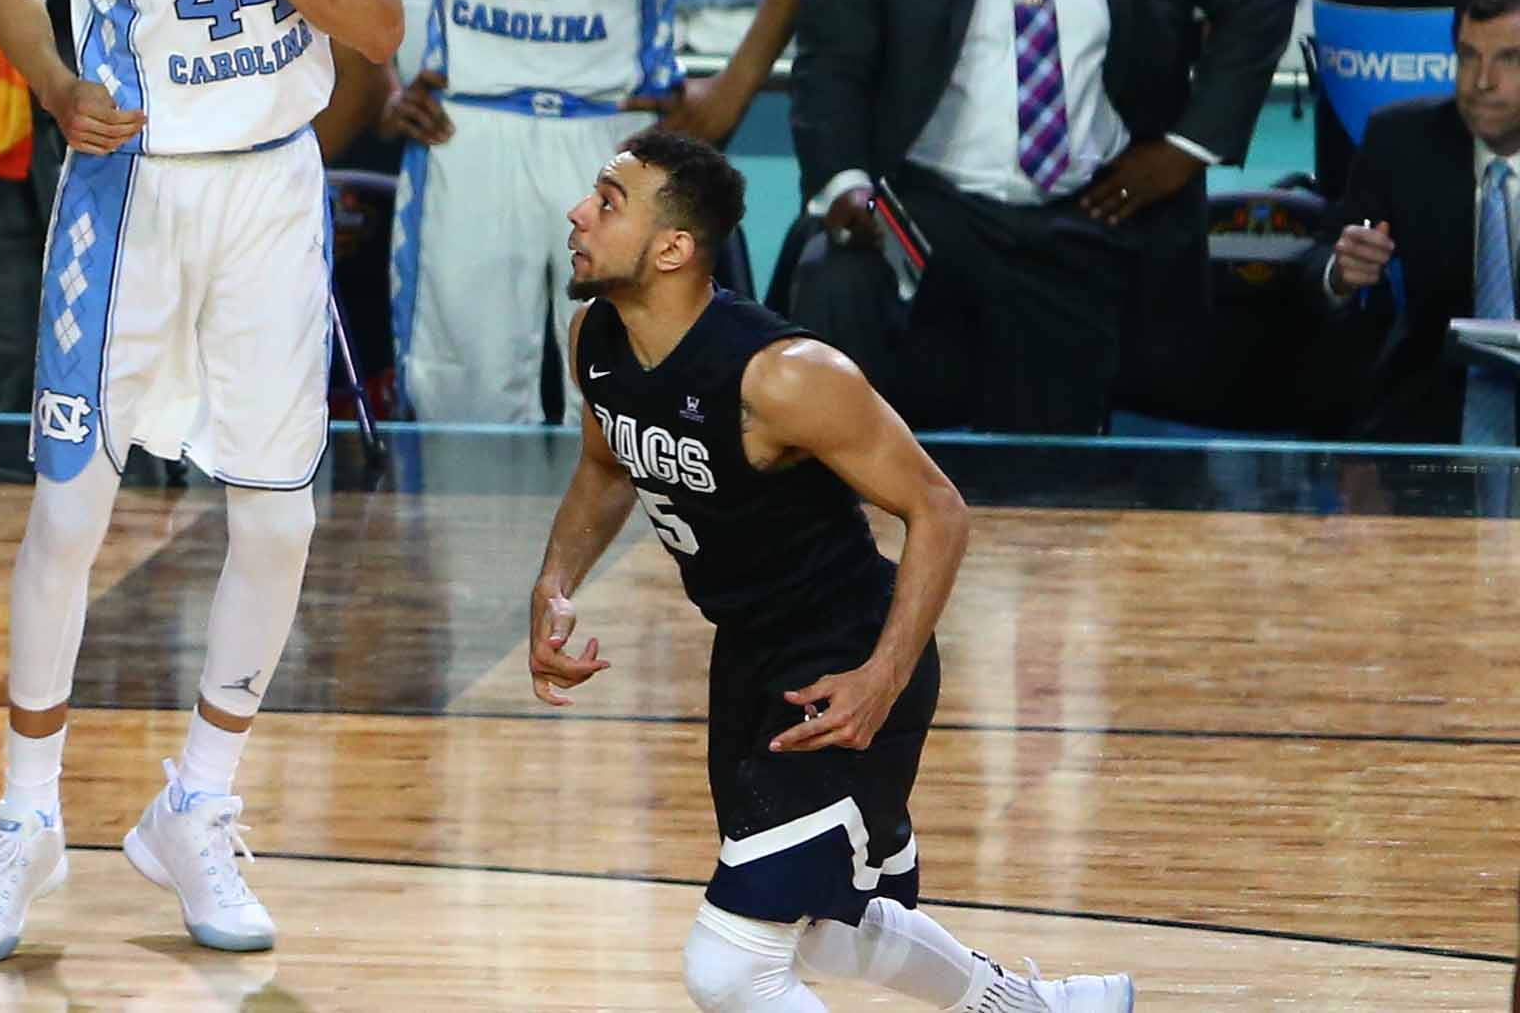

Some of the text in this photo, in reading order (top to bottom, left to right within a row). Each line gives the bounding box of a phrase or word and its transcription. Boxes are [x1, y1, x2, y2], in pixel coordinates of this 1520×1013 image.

[168, 17, 313, 86] CAROLINA
[1320, 46, 1460, 83] POWER
[636, 487, 700, 556] 5
